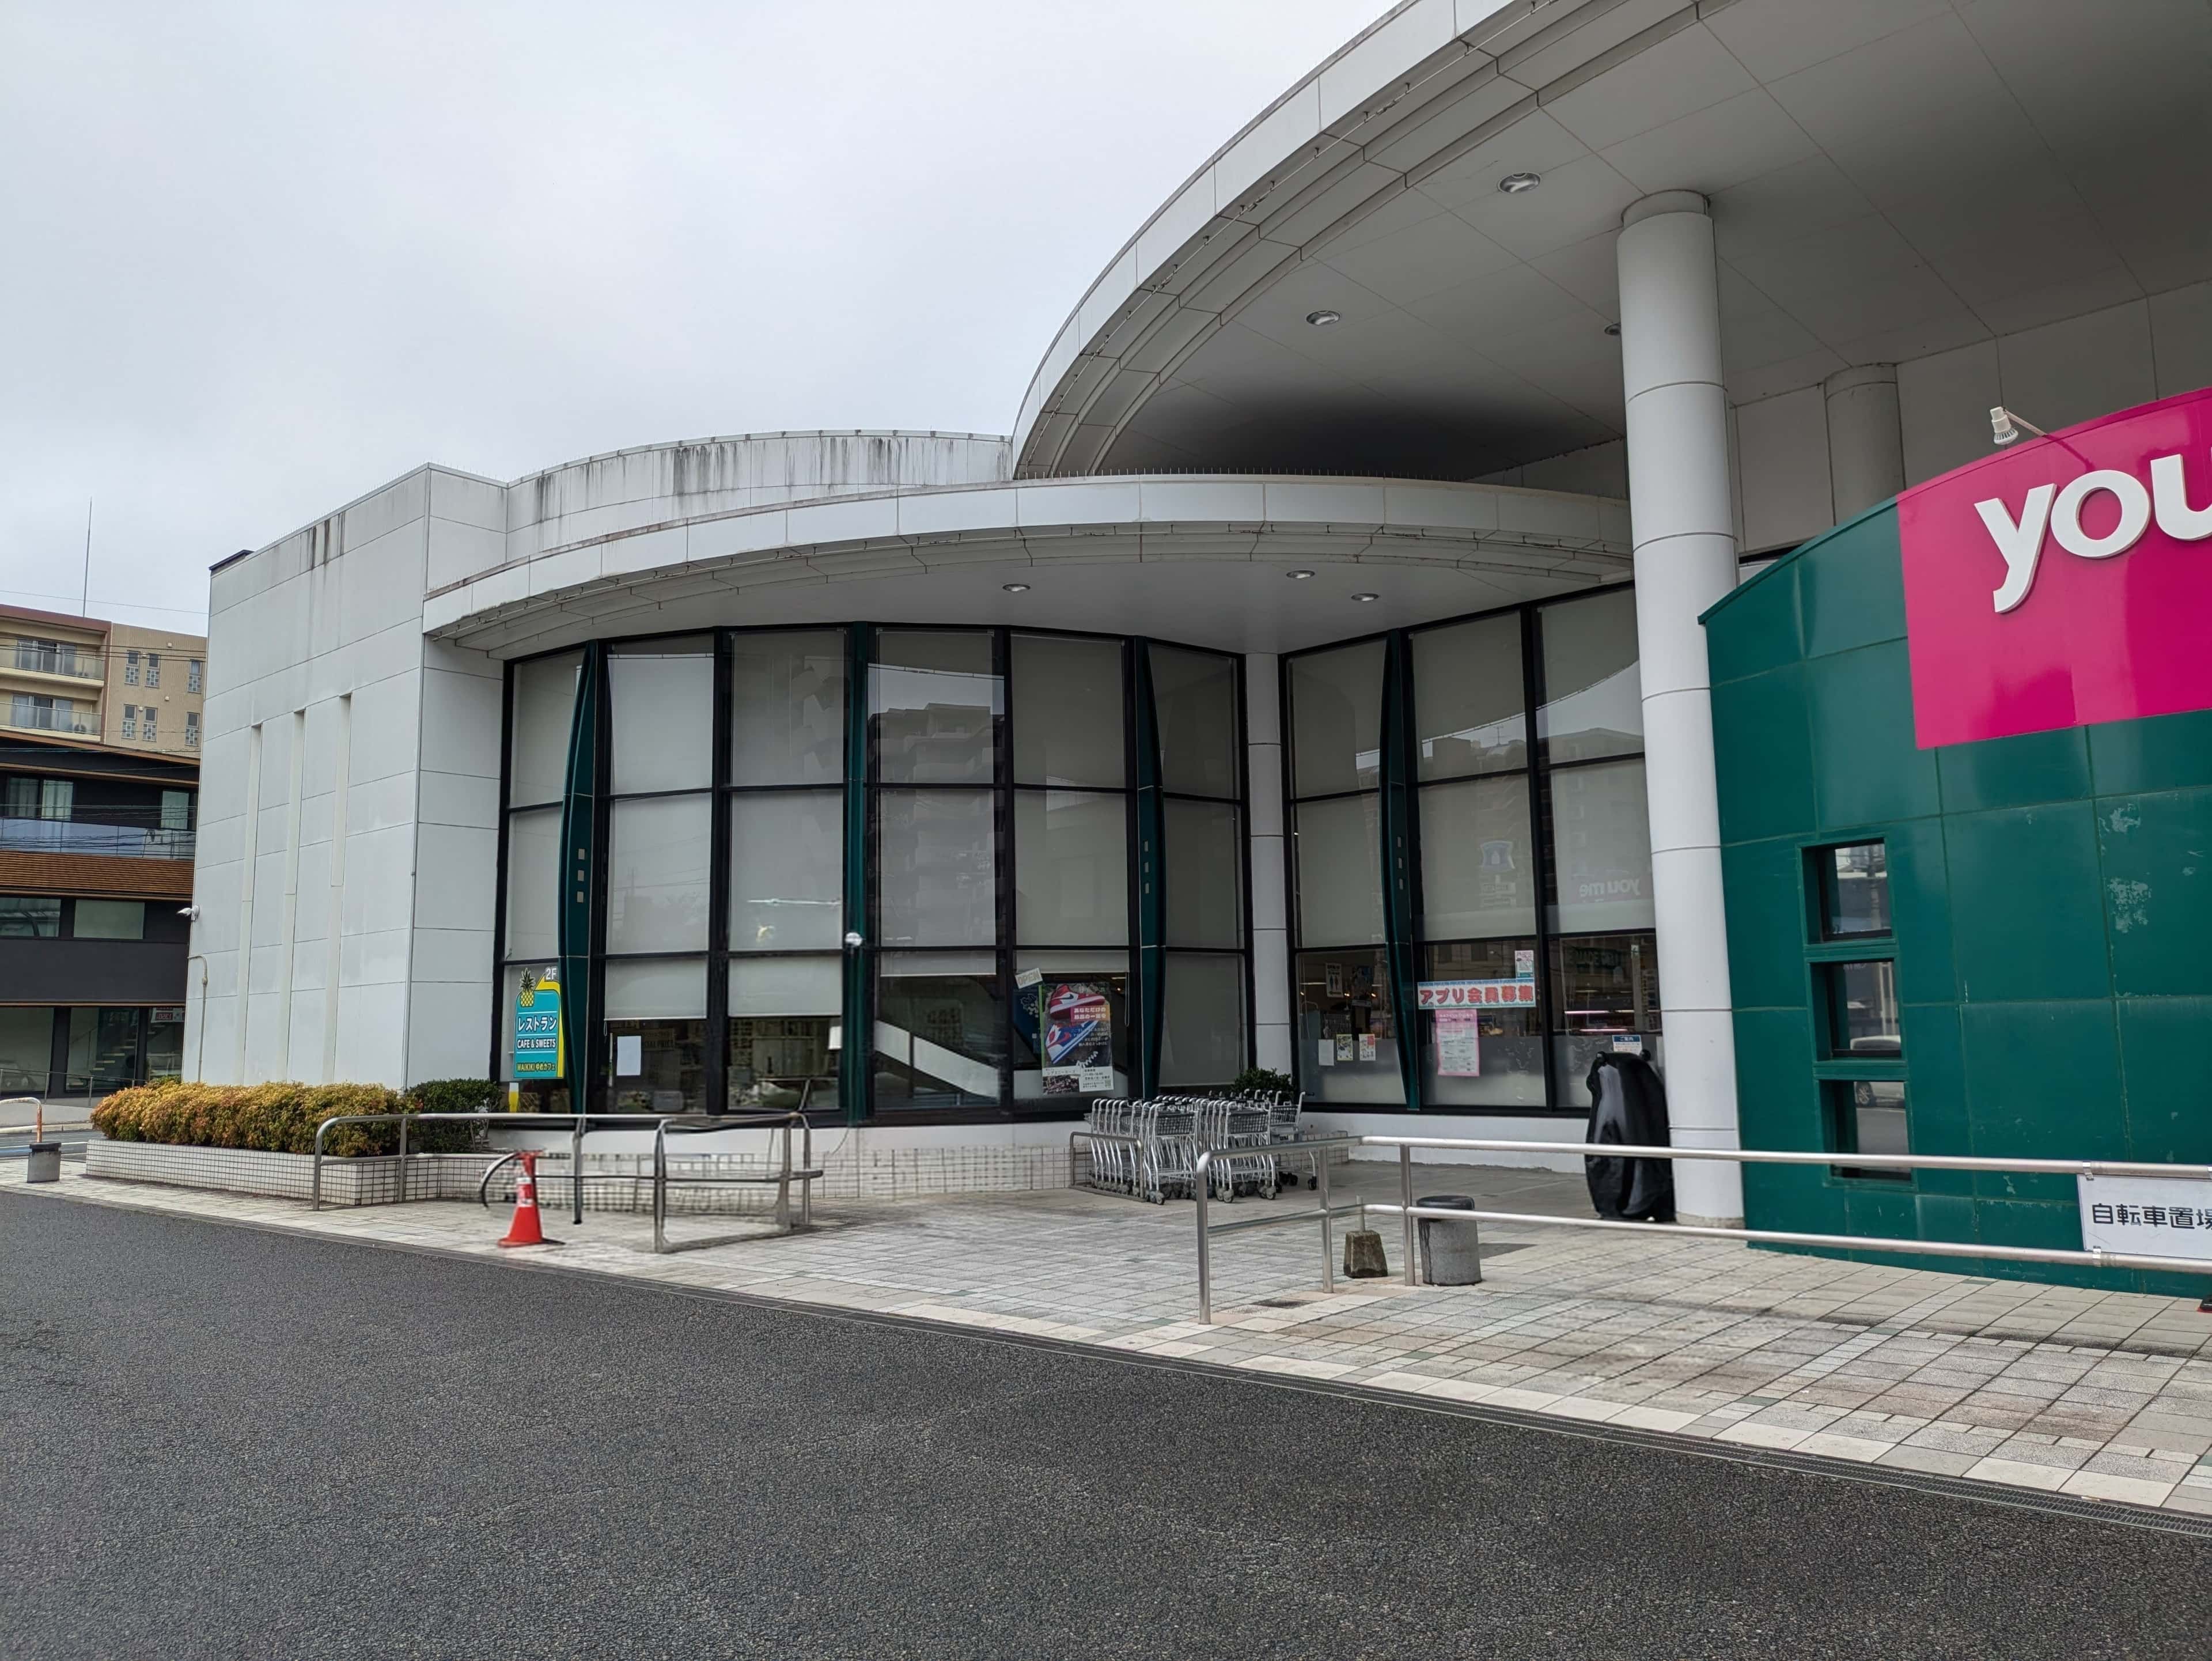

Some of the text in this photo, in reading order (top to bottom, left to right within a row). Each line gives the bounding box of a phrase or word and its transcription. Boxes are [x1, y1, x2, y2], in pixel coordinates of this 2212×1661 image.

[546, 967, 558, 980] 2F
[1419, 985, 1533, 1005] アプリ会員募集
[517, 1016, 557, 1032] レストラン
[517, 1038, 556, 1049] CAFE & SWEETS
[517, 1063, 535, 1071] WAIKIKI
[2092, 1203, 2212, 1230] 自転車置場
